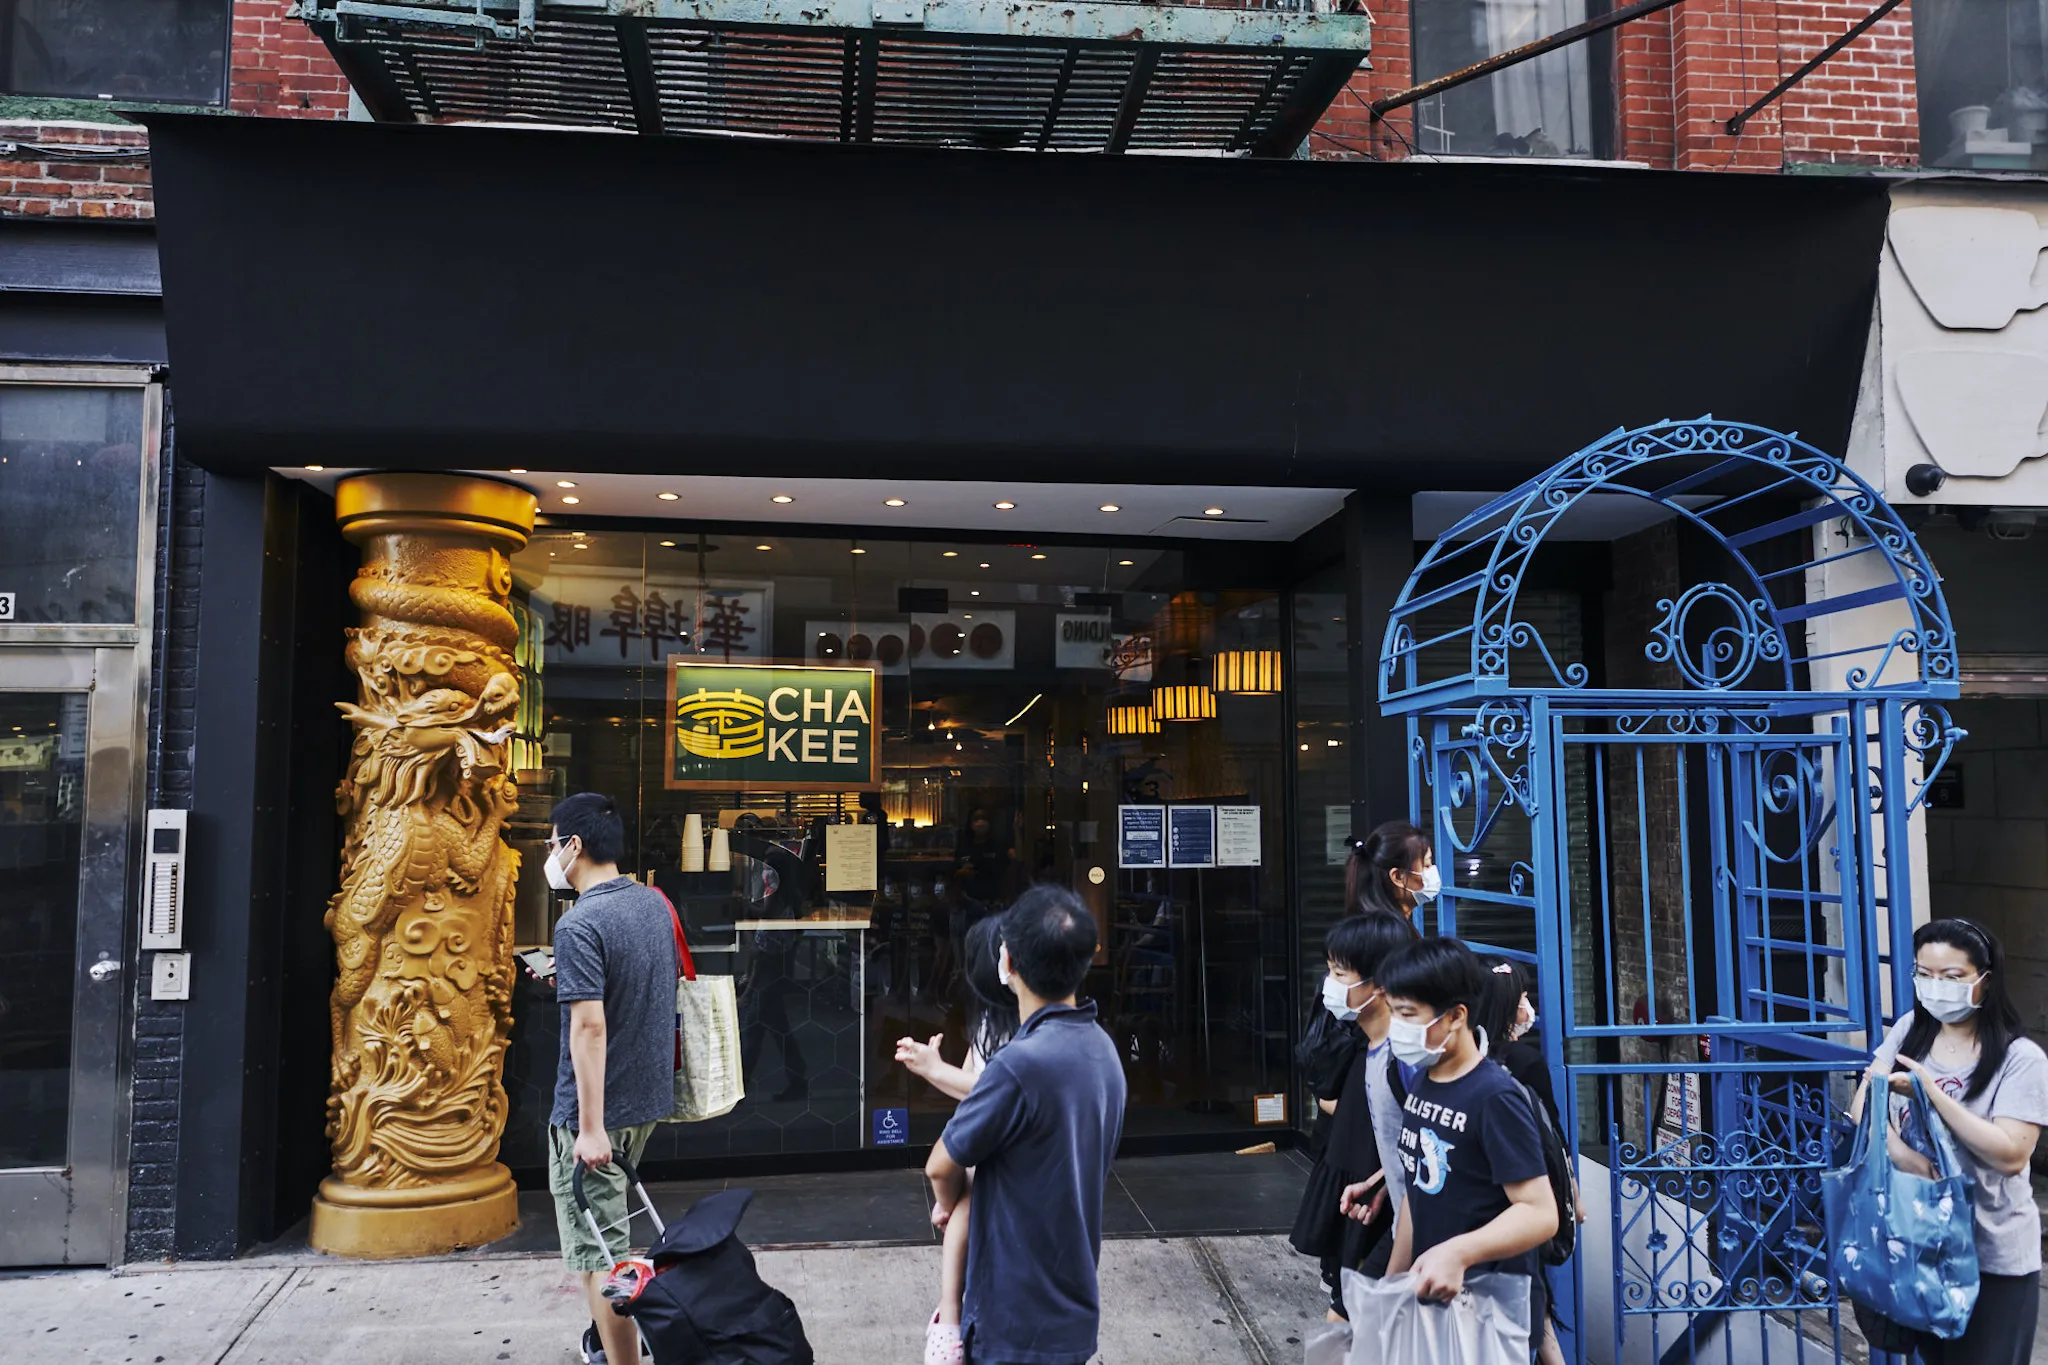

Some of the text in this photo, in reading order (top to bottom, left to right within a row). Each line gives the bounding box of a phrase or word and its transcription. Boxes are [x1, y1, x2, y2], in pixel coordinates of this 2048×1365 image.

[0, 597, 10, 615] 3
[768, 687, 870, 724] CHA
[768, 727, 859, 763] KEE
